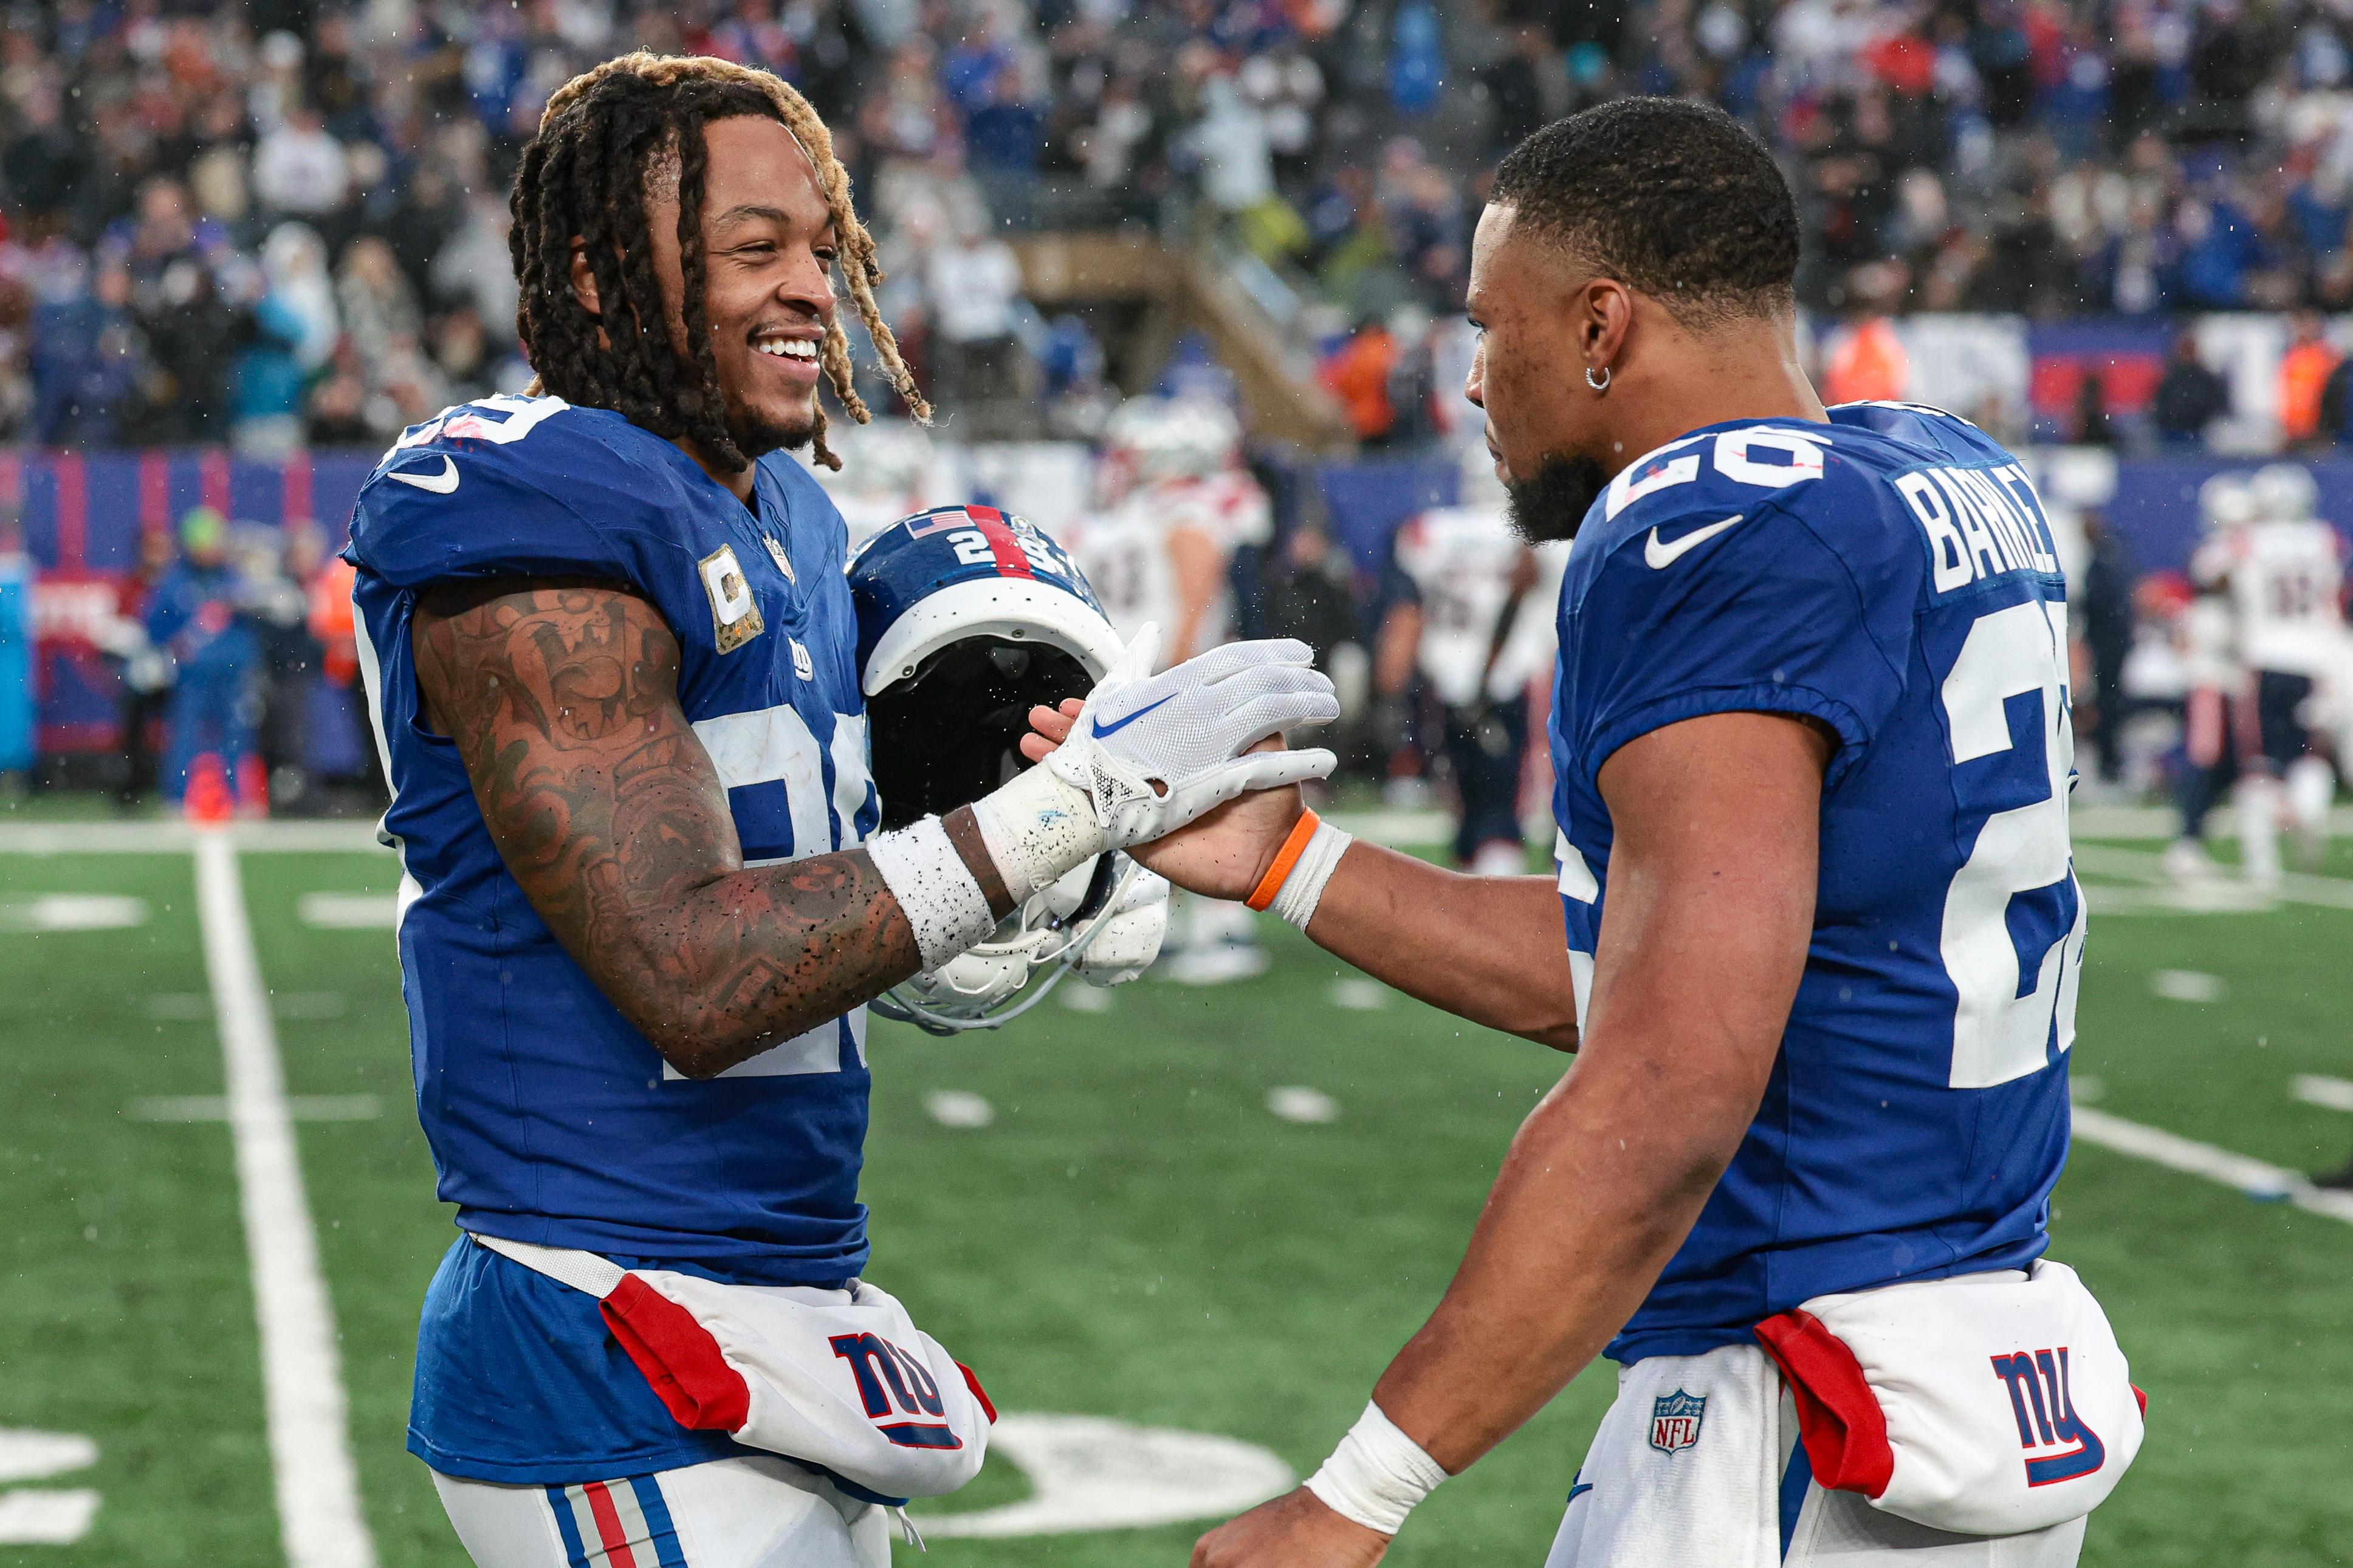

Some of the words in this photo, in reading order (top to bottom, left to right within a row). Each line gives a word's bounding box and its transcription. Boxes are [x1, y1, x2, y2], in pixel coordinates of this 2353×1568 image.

[1606, 425, 1833, 523] 26
[707, 552, 751, 625] C
[1654, 1419, 1694, 1448] NFL
